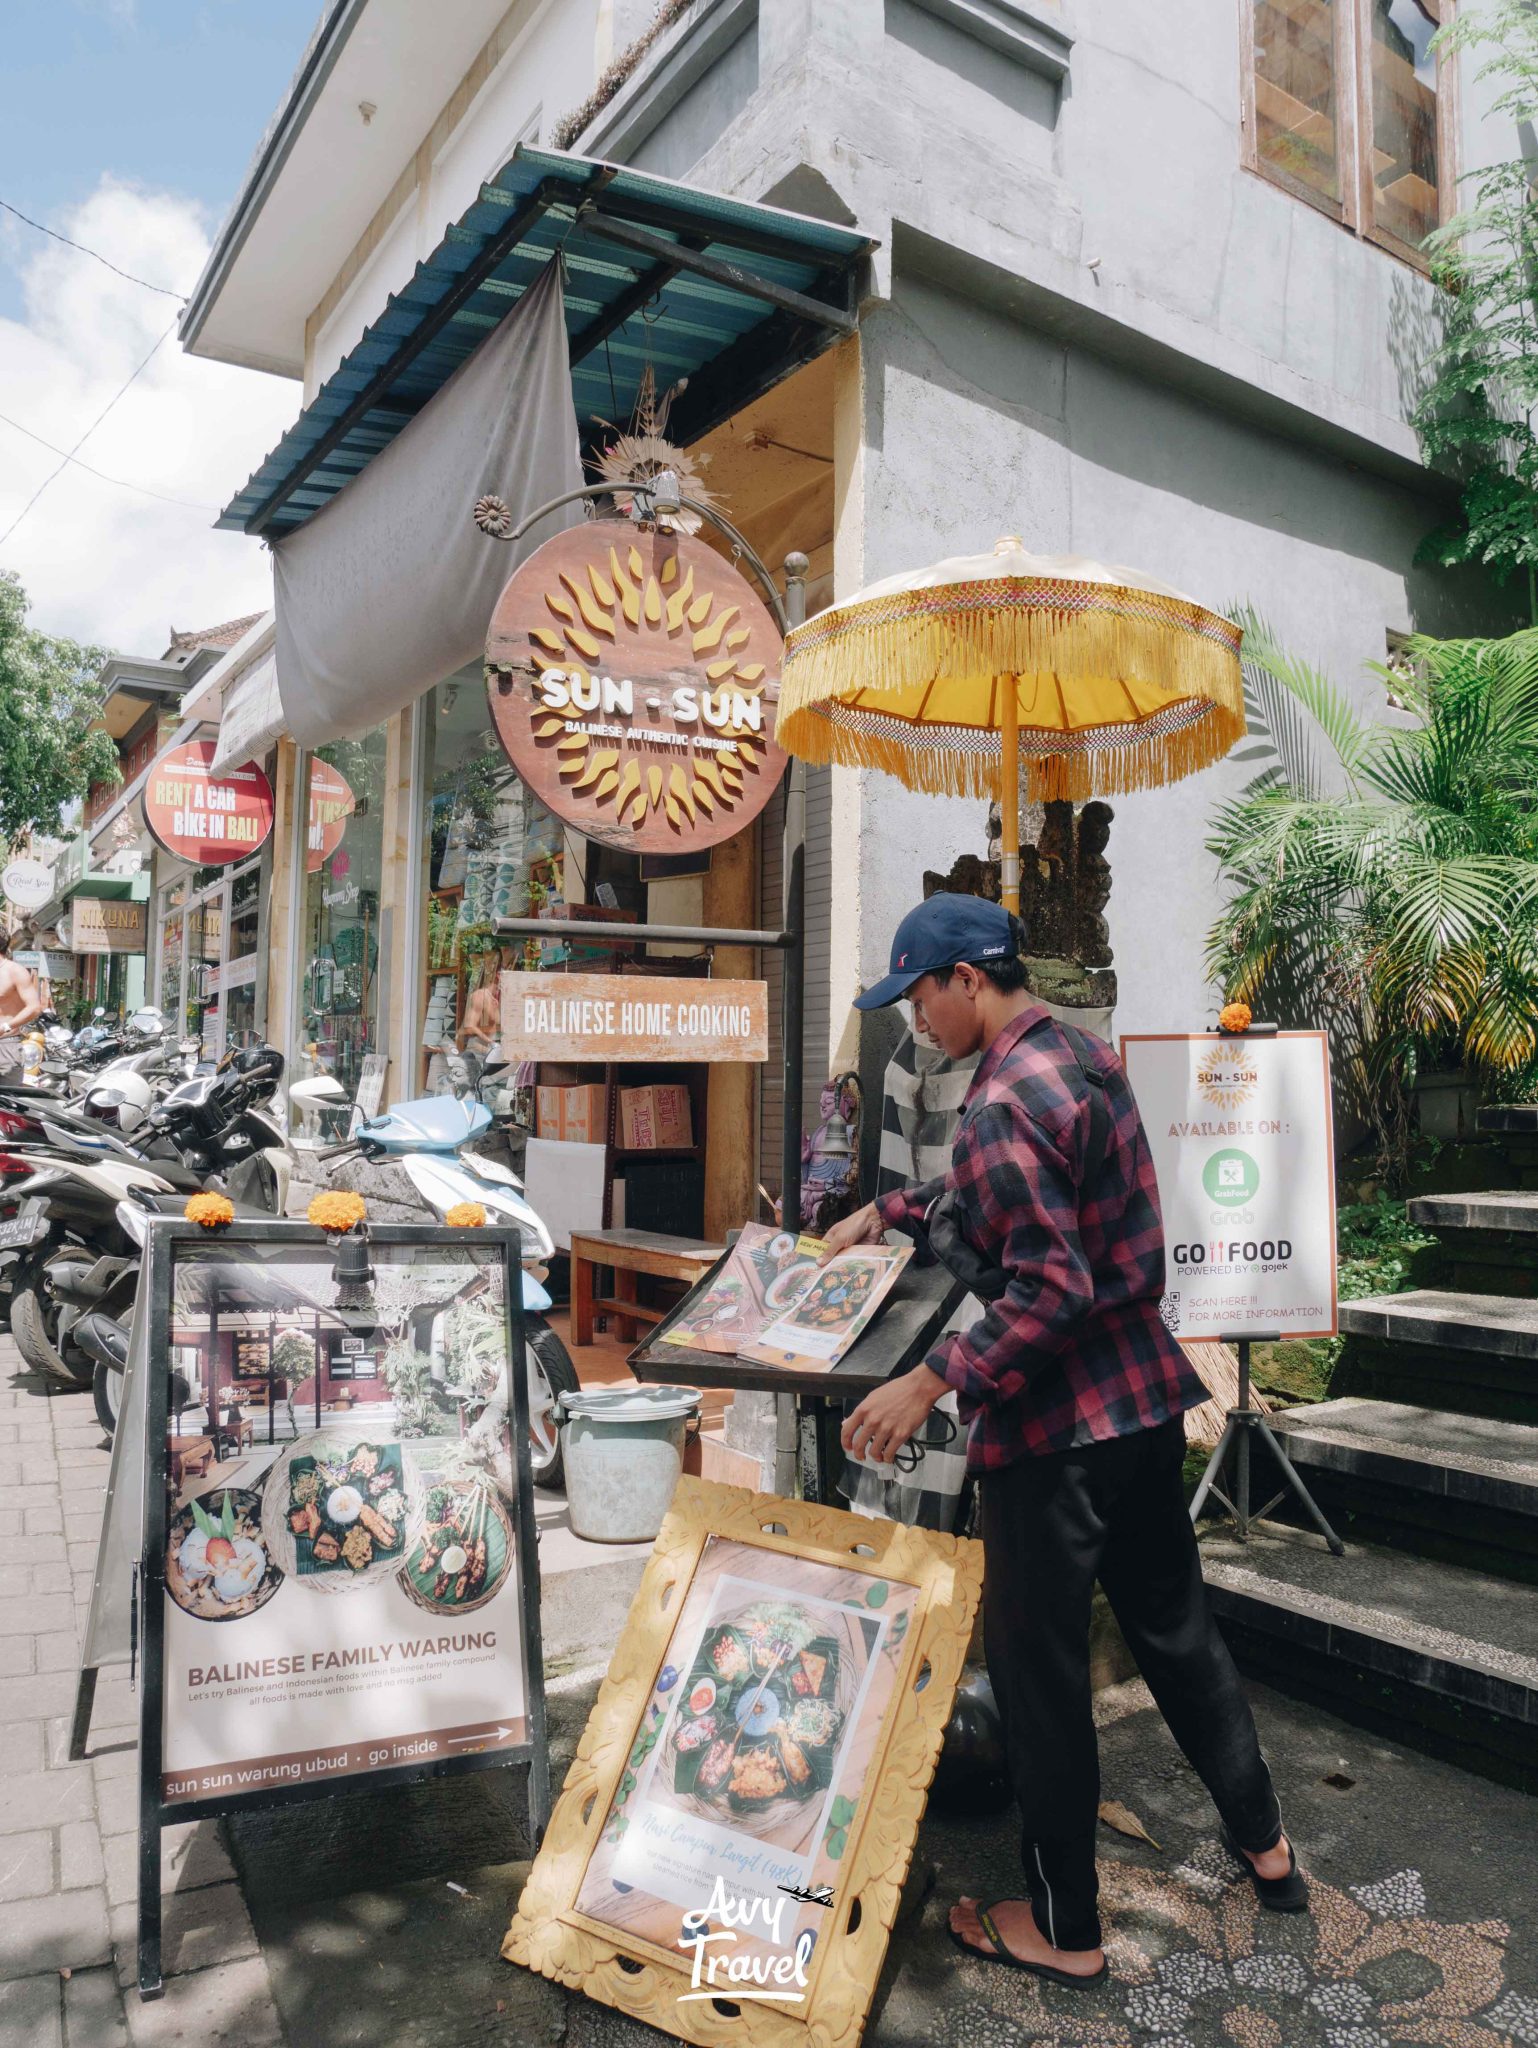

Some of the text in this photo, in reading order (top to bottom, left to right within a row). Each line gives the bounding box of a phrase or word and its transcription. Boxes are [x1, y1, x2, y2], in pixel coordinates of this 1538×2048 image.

[539, 668, 634, 716] SUN
[672, 687, 761, 731] SUN
[564, 720, 738, 753] BALINESE AUTHENTIC CUISINE
[155, 781, 235, 811] RENT A CAR
[174, 811, 258, 842] BIKE IN BALI
[81, 908, 140, 929] NIKUNA
[524, 999, 751, 1038] BALINESE HOME COOKING
[1197, 1072, 1223, 1083] SUN
[1233, 1072, 1258, 1082] SUN
[1168, 1121, 1254, 1137] AVAILABLE
[1258, 1120, 1281, 1134] ON
[1214, 1189, 1249, 1198] GrabFood
[1210, 1208, 1254, 1226] Grab
[1173, 1240, 1292, 1265] GO FOOD
[1177, 1263, 1288, 1276] POWERED BY gojek
[1188, 1306, 1324, 1322] FOR MORE INFORMATION
[1189, 1298, 1218, 1308] SCAN
[1220, 1296, 1247, 1307] HERE
[188, 1631, 497, 1687] BALINESE FAMILY WARUNG
[188, 1653, 496, 1702] Let's try Balinese and Indonesian foods within Balinese family compound
[249, 1672, 442, 1706] all foods is made with love and no msg added
[166, 1779, 197, 1795] sun
[202, 1773, 233, 1790] sun
[237, 1762, 301, 1782] warung
[305, 1752, 348, 1773] ubud
[369, 1750, 389, 1765] go
[393, 1739, 438, 1759] inside
[641, 1812, 804, 1887] Nasi Campur Langit (48K)
